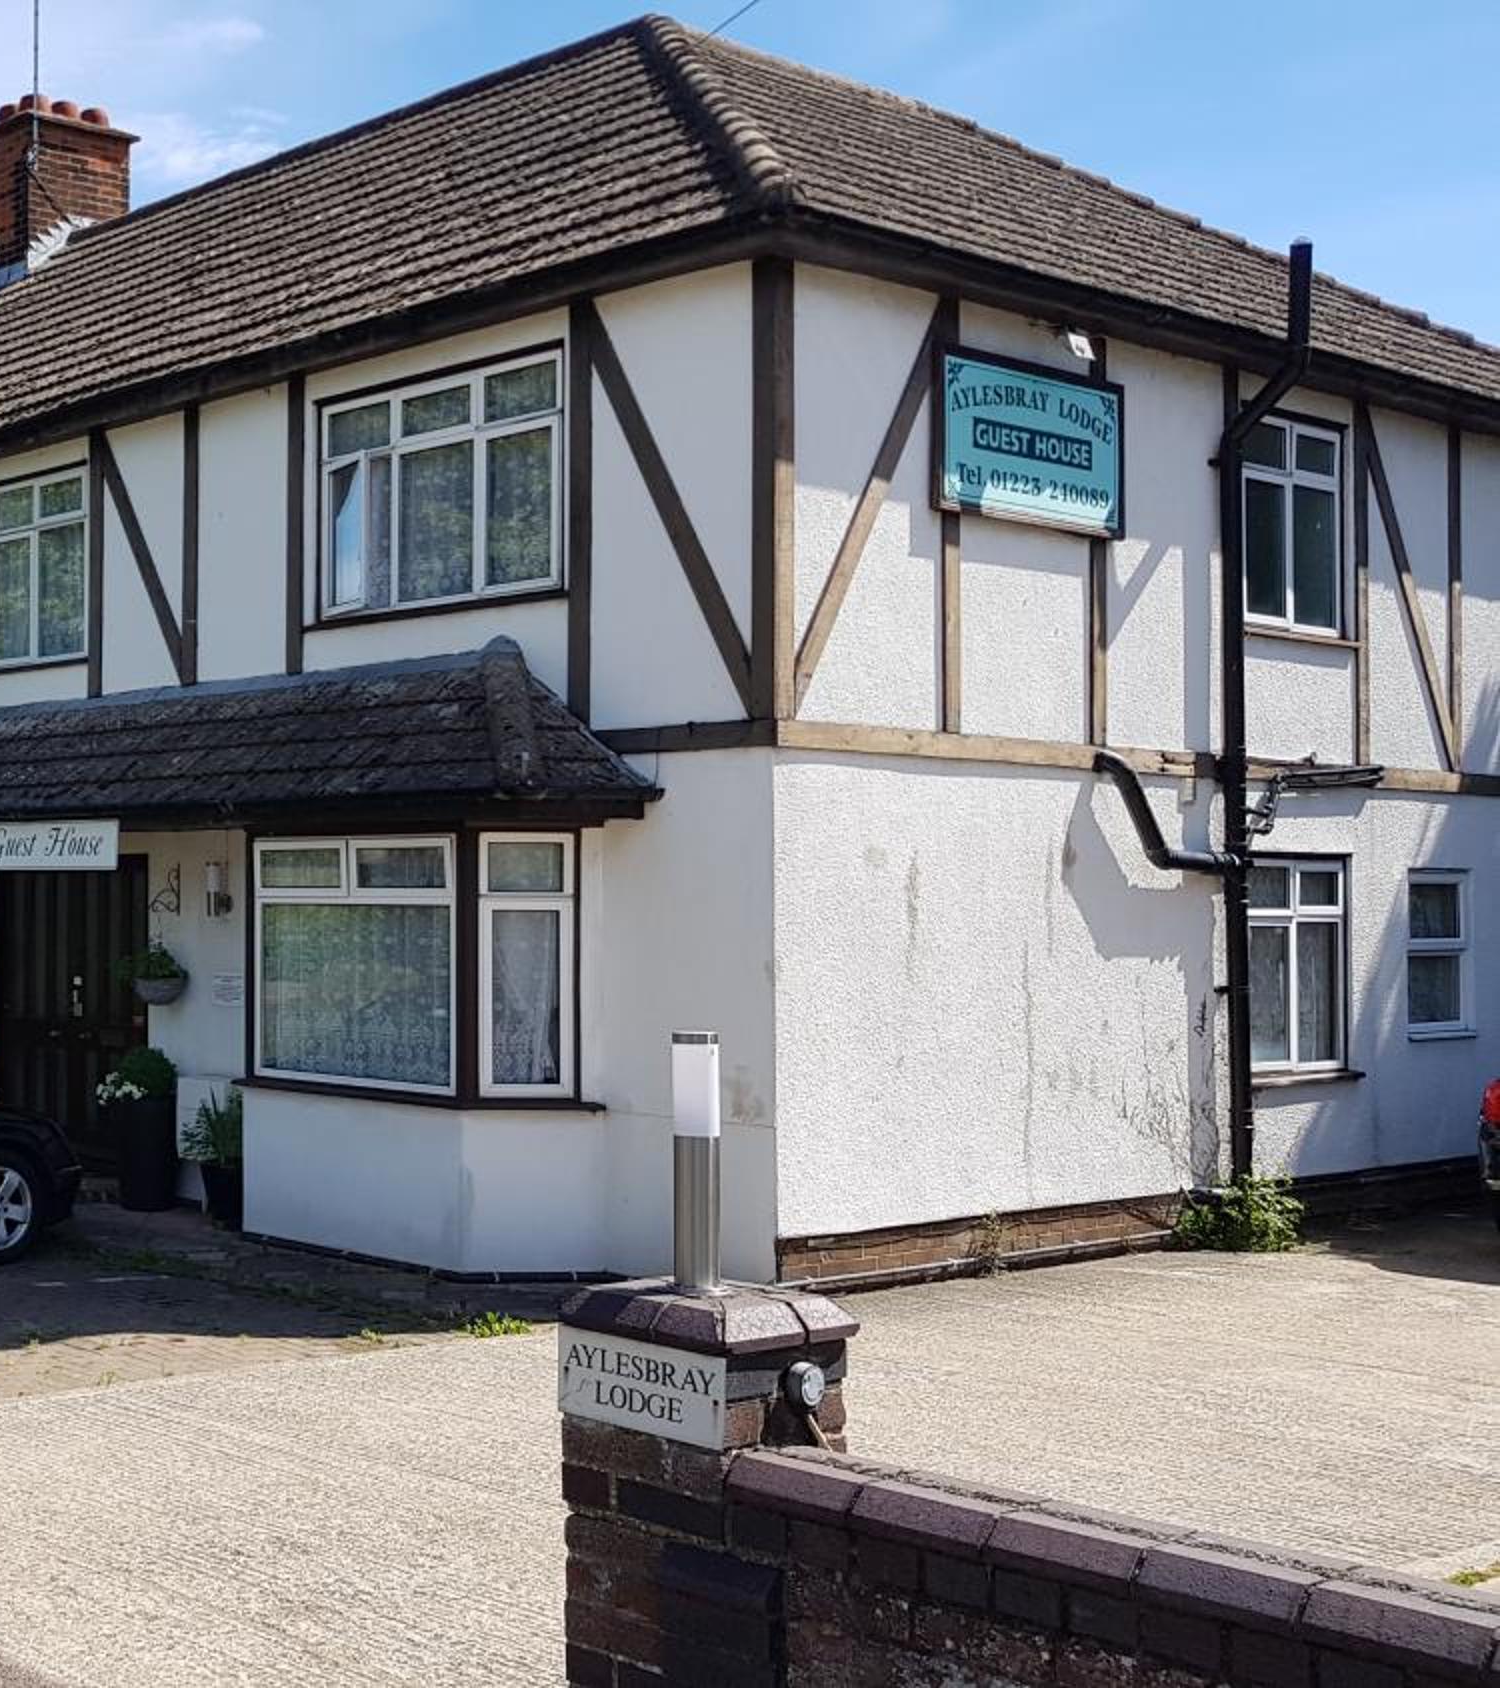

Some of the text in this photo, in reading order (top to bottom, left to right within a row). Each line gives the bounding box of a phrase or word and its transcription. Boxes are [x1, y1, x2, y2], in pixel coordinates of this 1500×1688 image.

[951, 384, 1113, 445] AYLESBRAY LODGE
[975, 422, 1092, 467] GUEST HOUSE
[990, 469, 1041, 496] 01223
[1049, 479, 1109, 509] 240089
[44, 827, 103, 857] House
[565, 1344, 716, 1396] AYLESBRAY
[595, 1380, 683, 1424] LODGE
